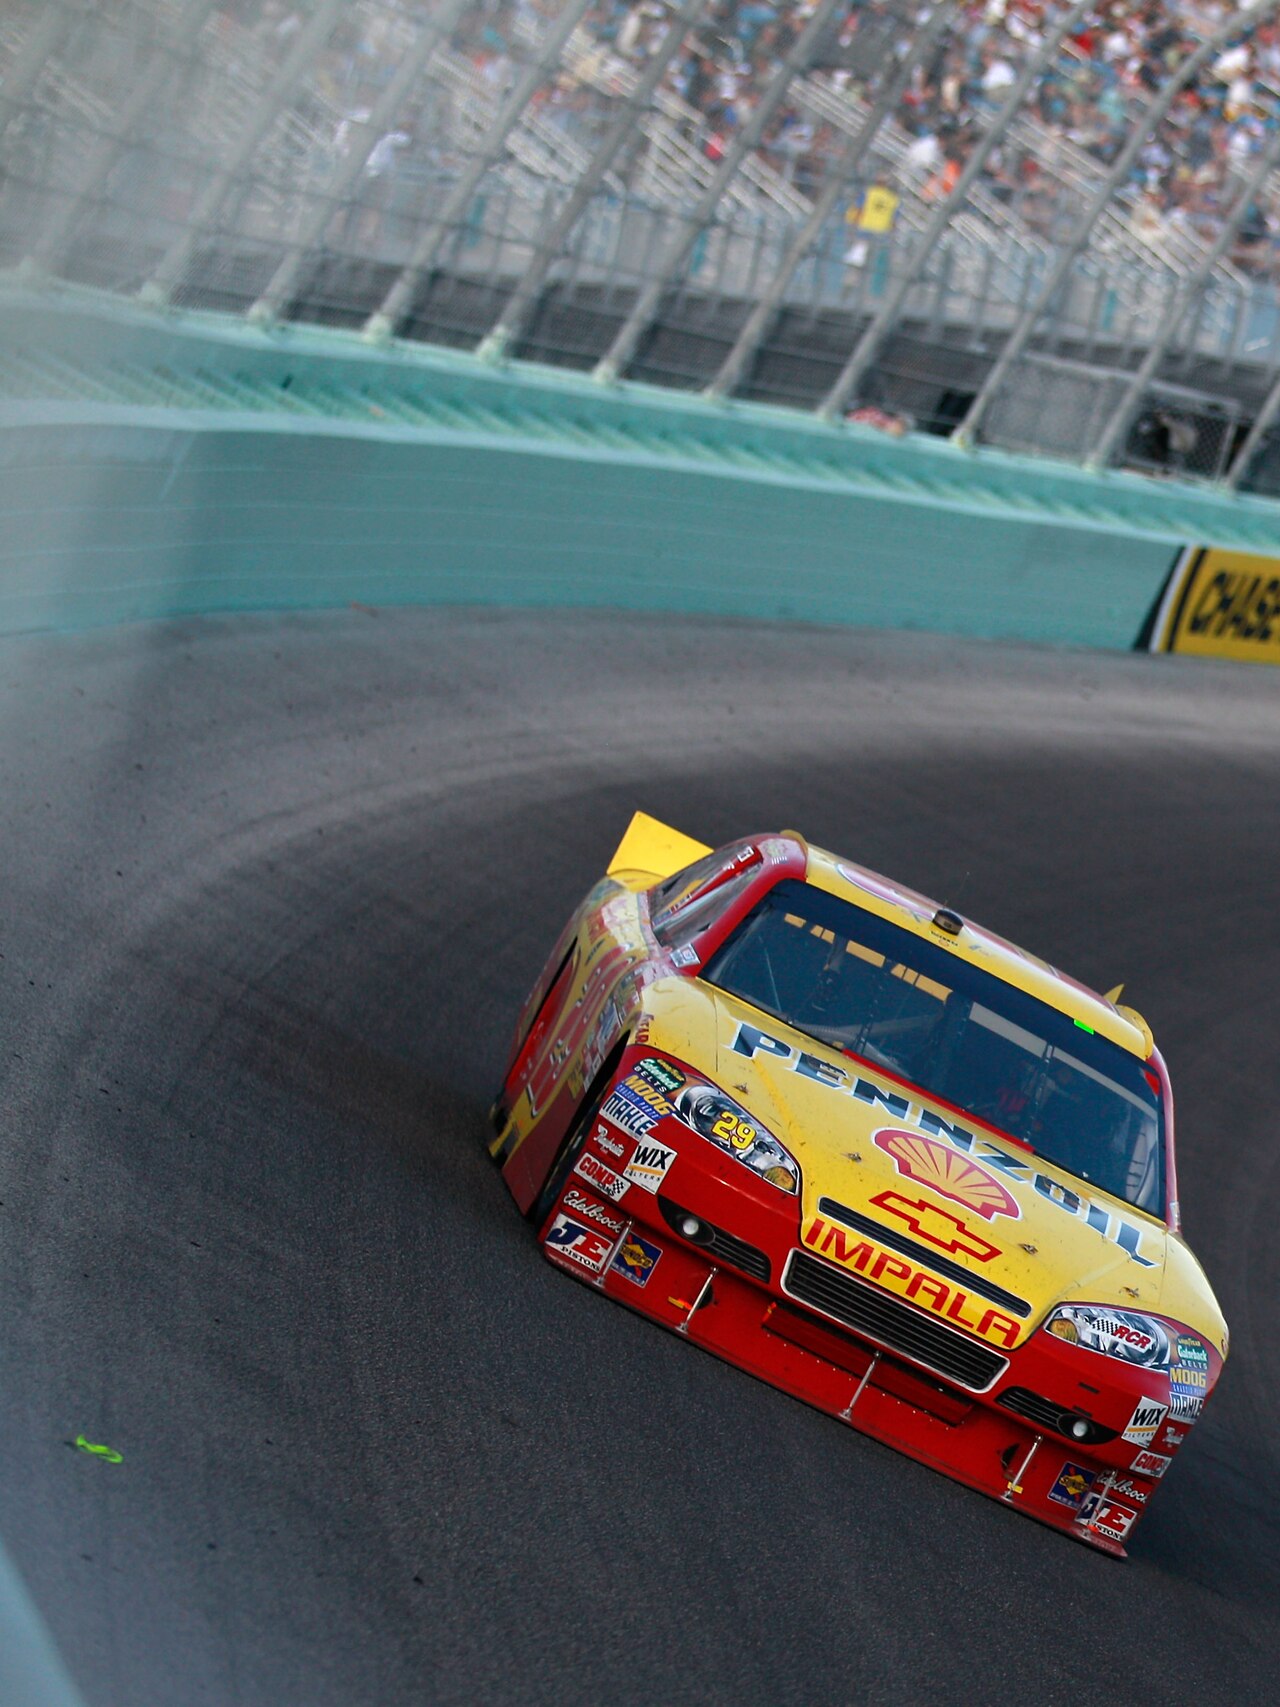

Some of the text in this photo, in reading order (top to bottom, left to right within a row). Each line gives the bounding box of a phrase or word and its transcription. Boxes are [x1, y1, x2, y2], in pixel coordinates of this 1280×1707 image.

[633, 1065, 668, 1094] BELTS
[620, 1073, 676, 1117] MOOG
[602, 1092, 653, 1136] MAHLE
[711, 1110, 758, 1151] 29
[730, 1021, 1161, 1269] PENNZOIL
[578, 1156, 618, 1187] COMP
[633, 1145, 674, 1171] WIX
[624, 1168, 662, 1183] FILTERS
[563, 1189, 625, 1235] Edelbrock
[545, 1220, 611, 1264] JE
[560, 1245, 601, 1272] PISTONS
[804, 1217, 1022, 1350] IMPALA
[1112, 1324, 1152, 1350] RCR
[1169, 1367, 1207, 1388] MOOG
[1181, 1359, 1208, 1371] BELTS
[1132, 1407, 1167, 1427] WIX
